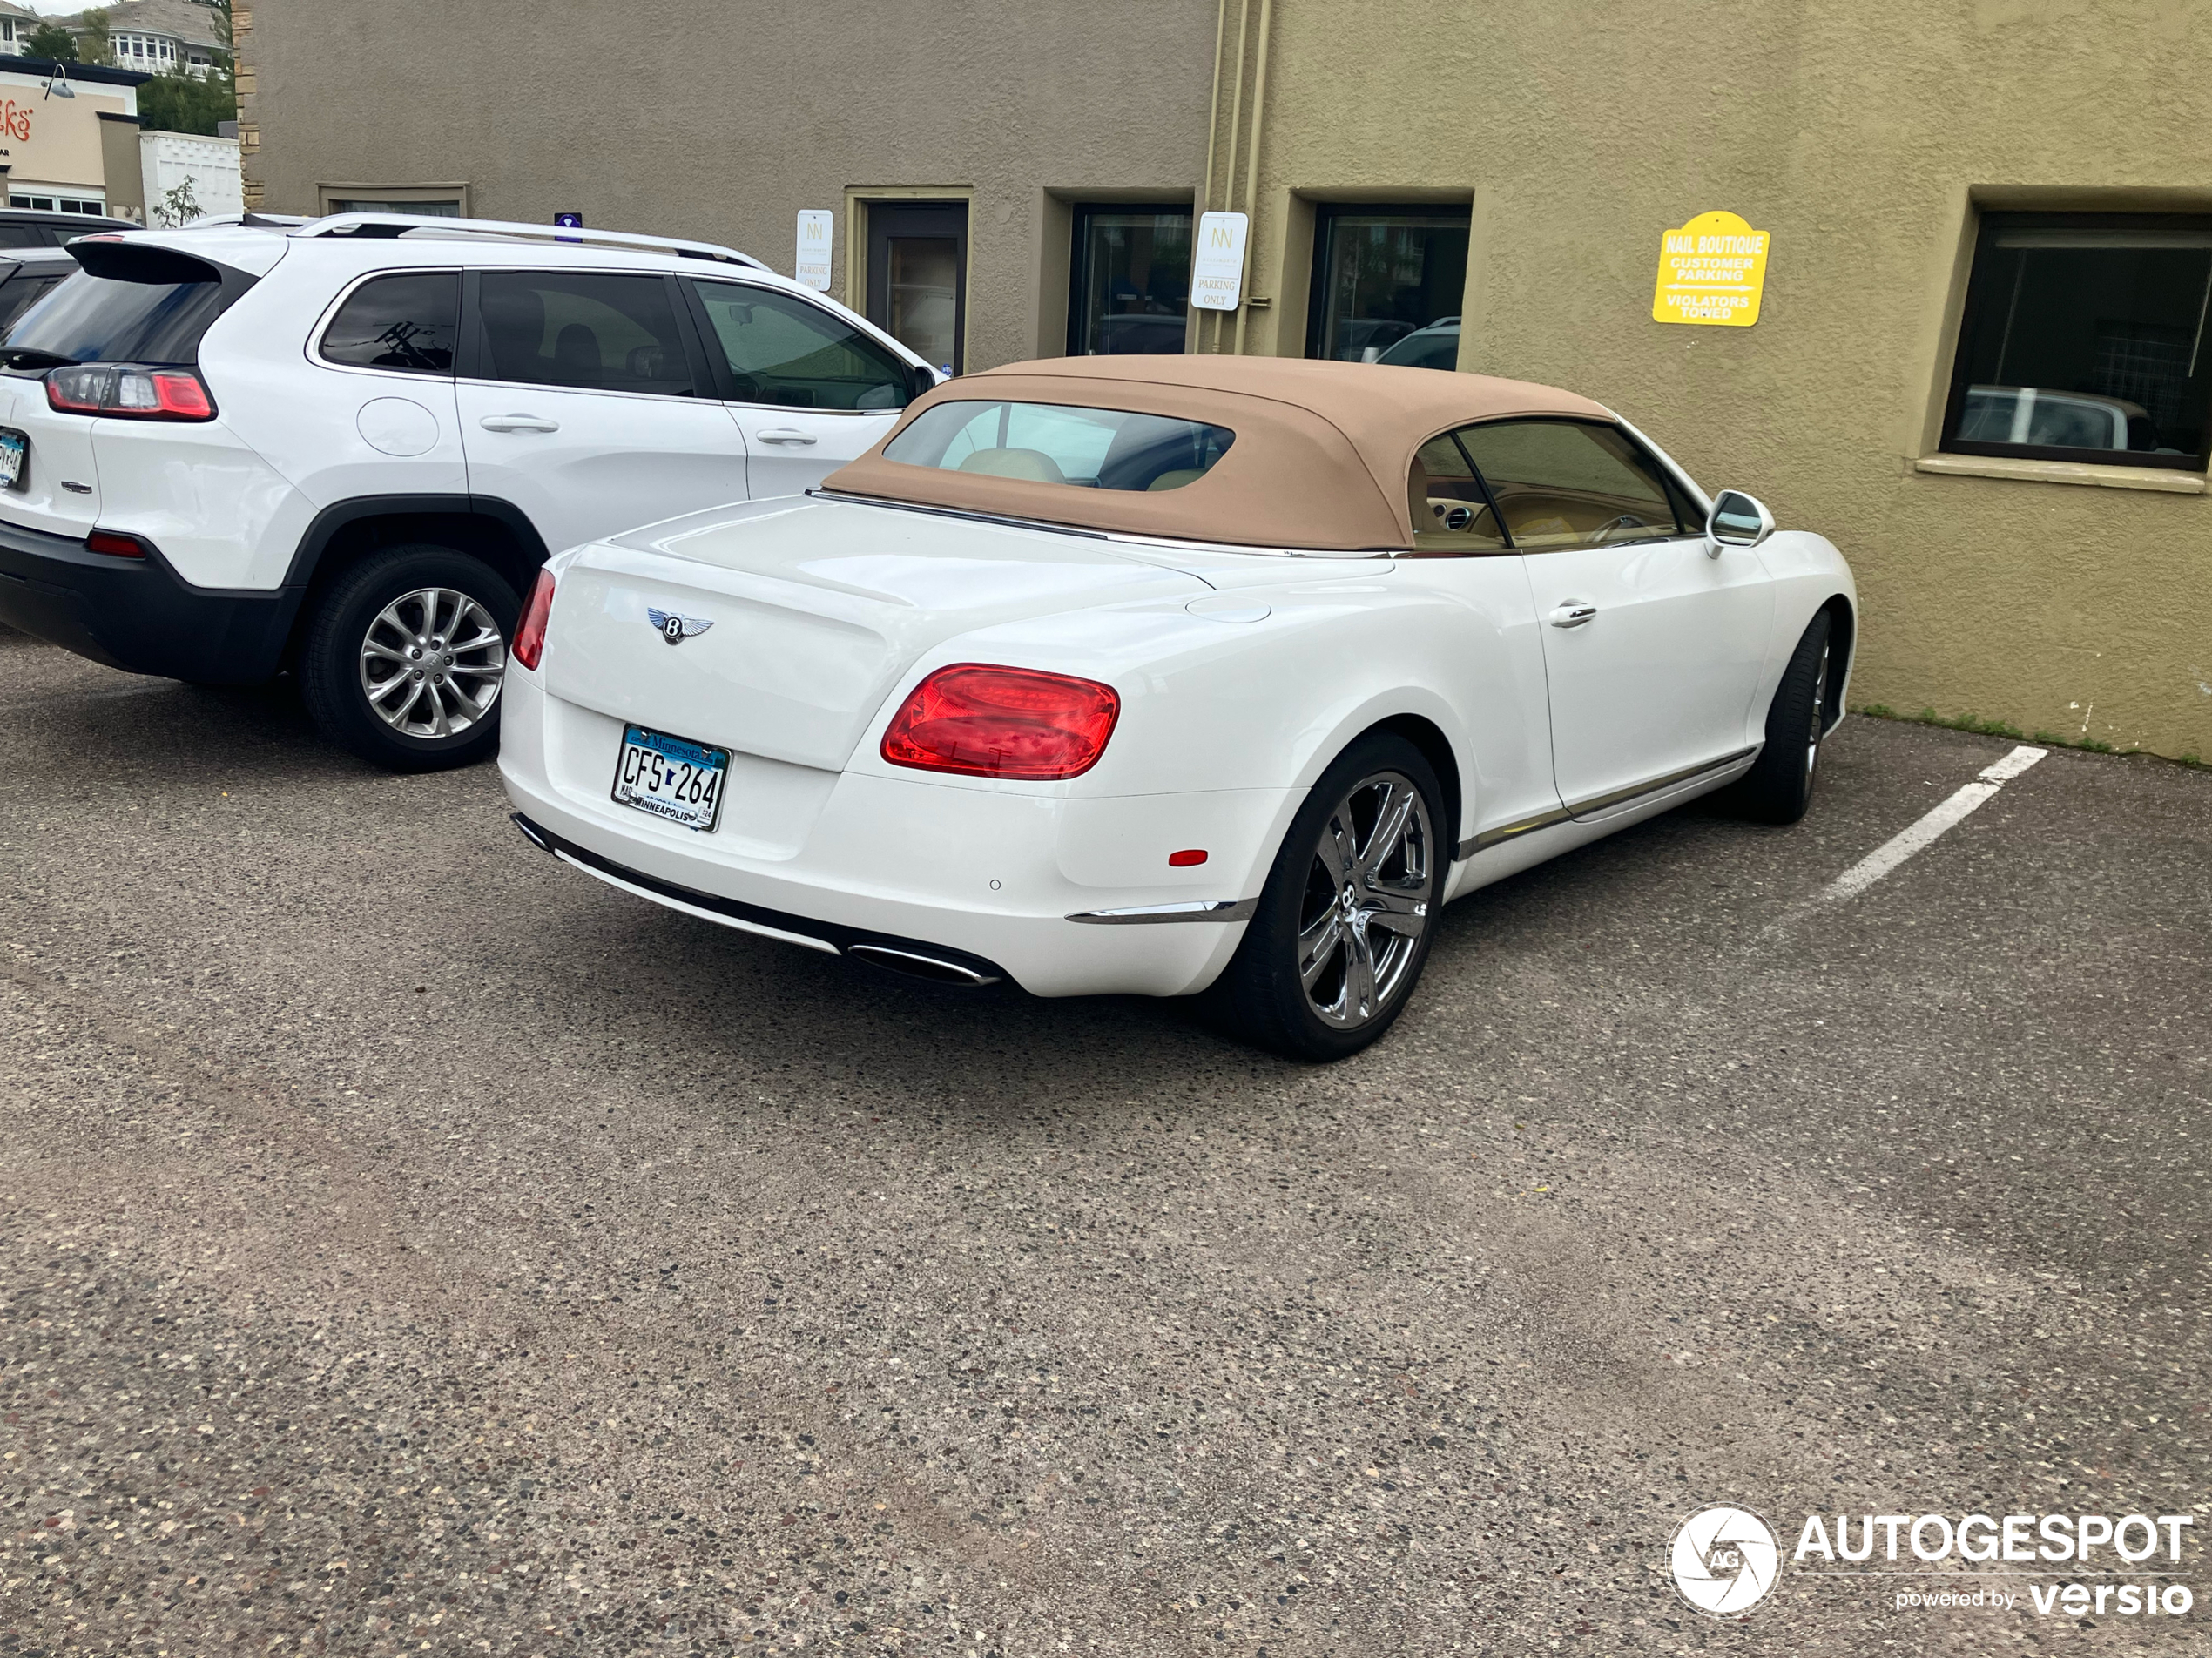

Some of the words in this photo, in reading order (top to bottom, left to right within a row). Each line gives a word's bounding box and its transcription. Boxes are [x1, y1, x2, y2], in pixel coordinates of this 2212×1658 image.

[1666, 235, 1695, 253] NAIL
[1697, 235, 1764, 254] BOUTIQUE
[1670, 257, 1754, 269] CUSTOMER
[799, 266, 827, 275] PARKING
[1676, 269, 1743, 281] PARKING
[805, 279, 822, 287] ONLY
[1198, 280, 1235, 291] PARKING
[1204, 294, 1227, 305] ONLY
[1666, 295, 1749, 308] VIOLATORS
[1680, 307, 1732, 319] TOWED
[652, 735, 700, 759] Minnesota
[624, 747, 664, 792] CFS
[675, 763, 718, 810] 264
[635, 796, 689, 821] MINNEAPOLIS
